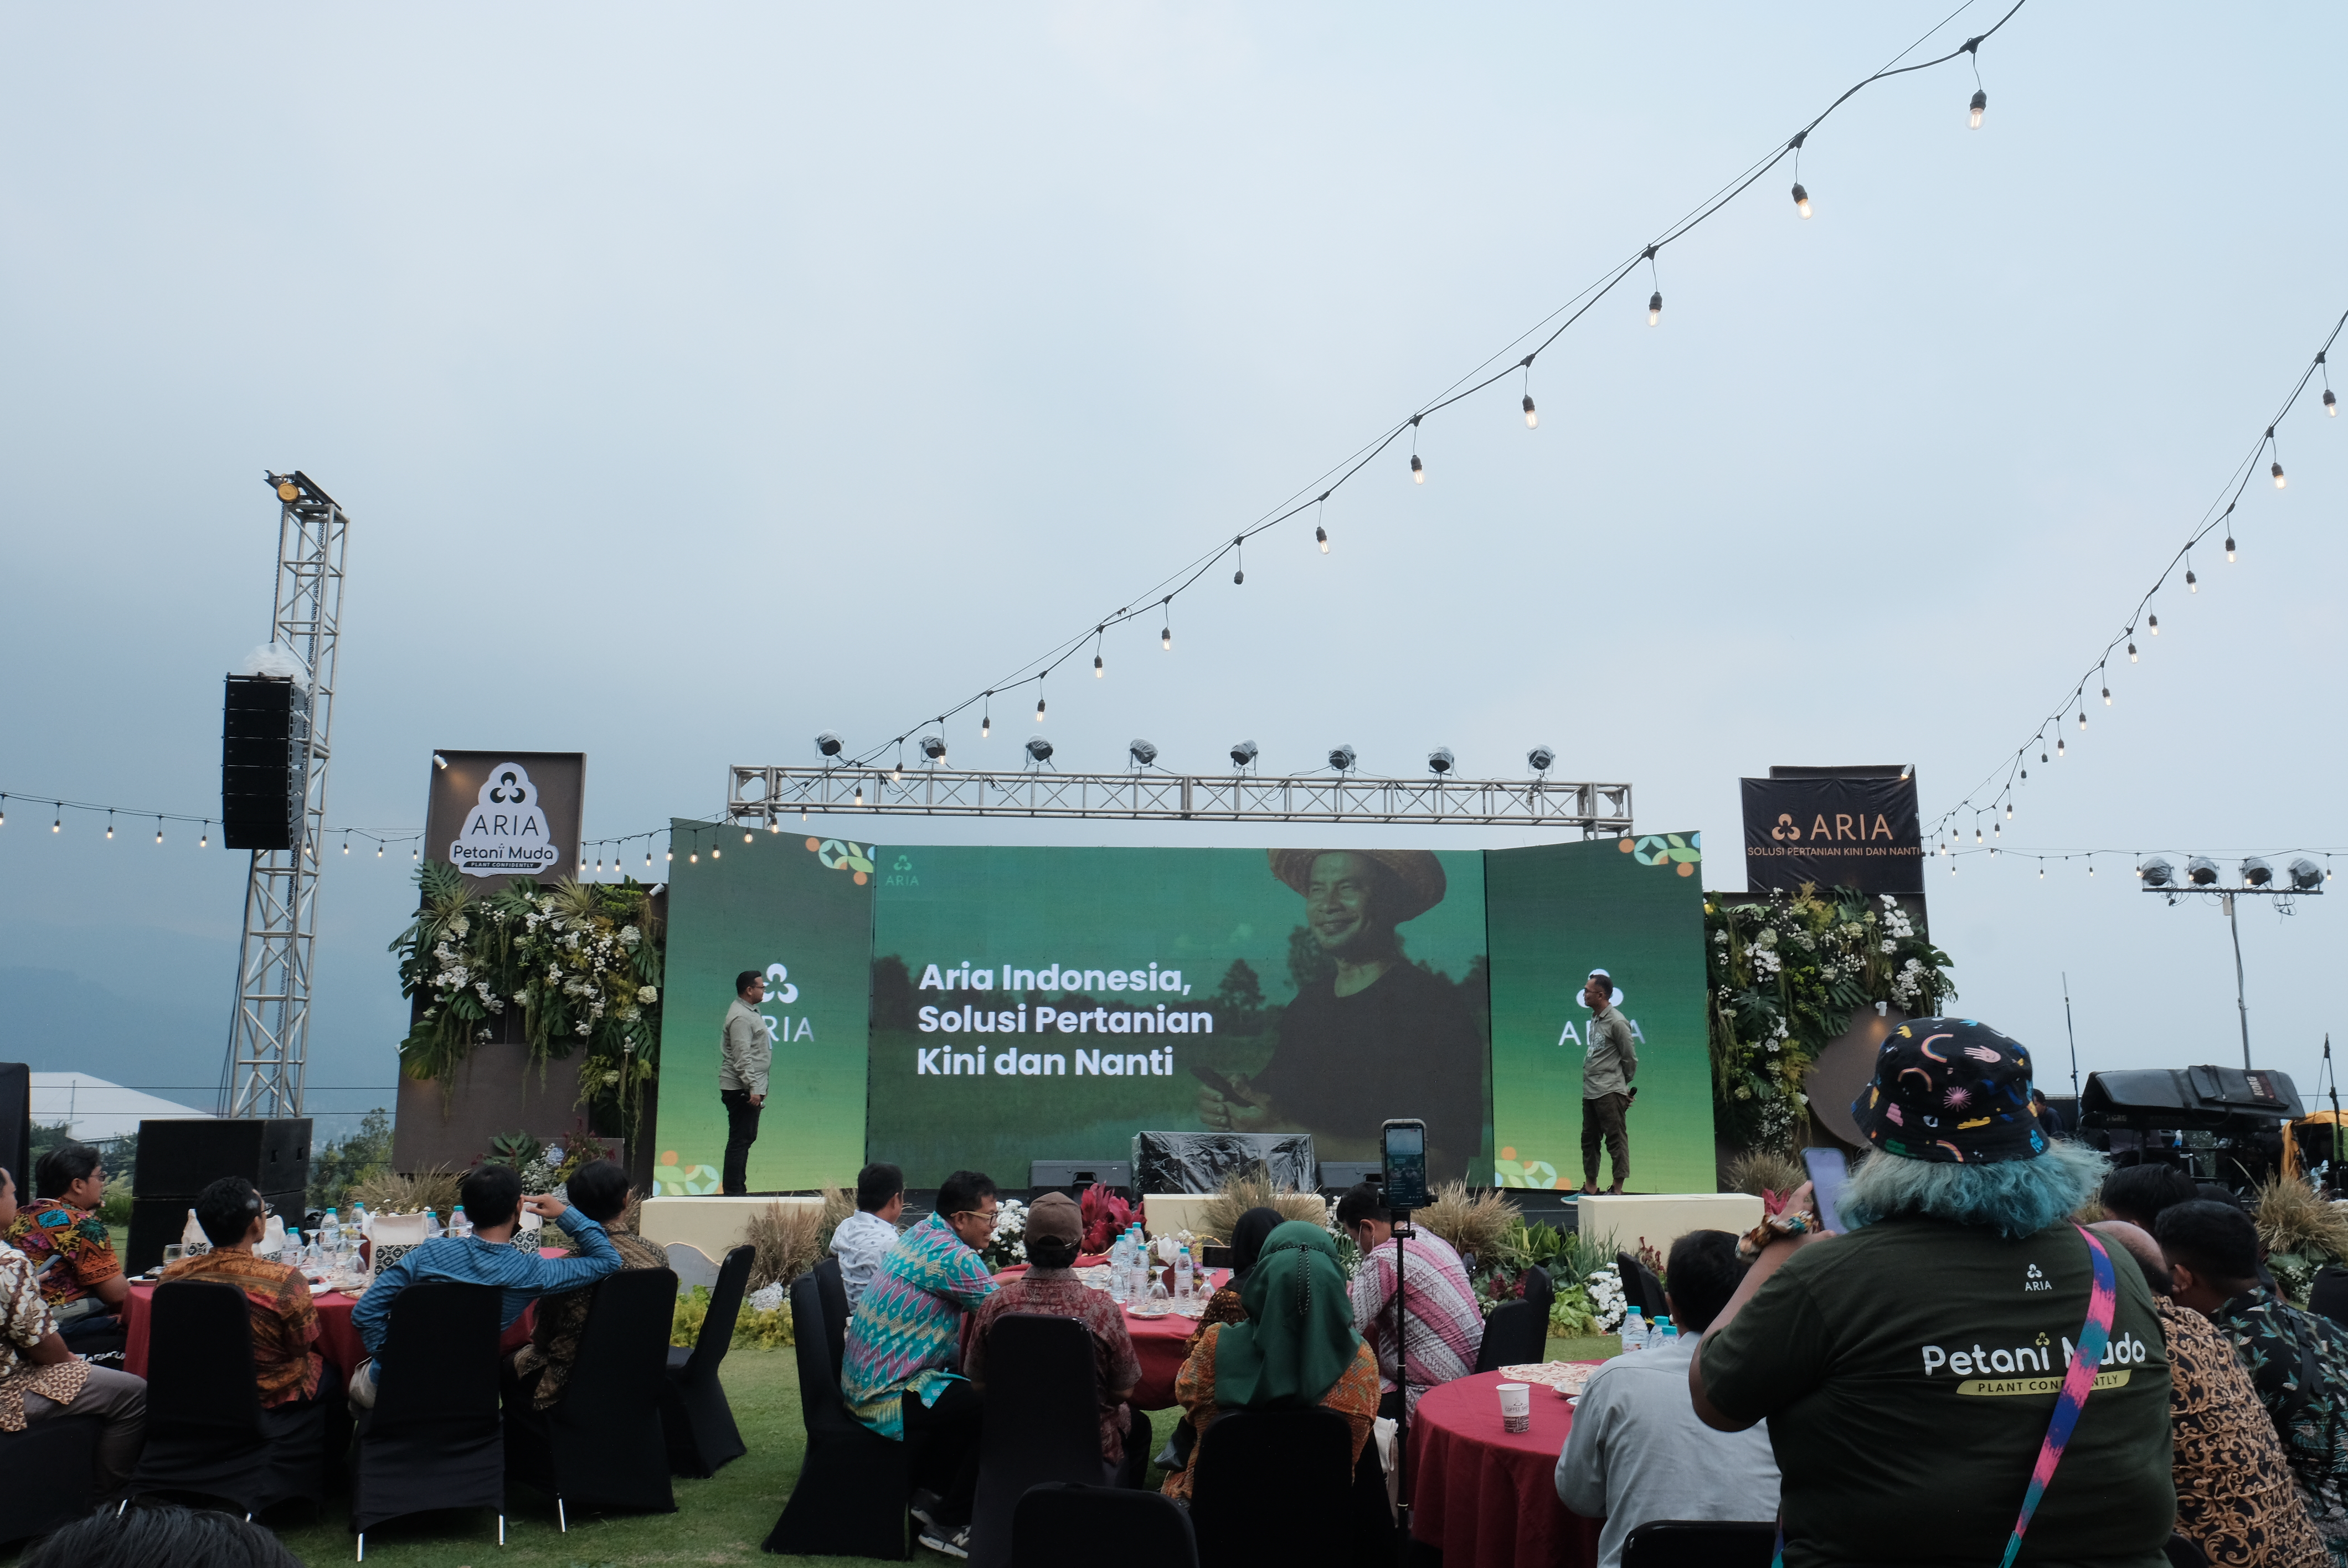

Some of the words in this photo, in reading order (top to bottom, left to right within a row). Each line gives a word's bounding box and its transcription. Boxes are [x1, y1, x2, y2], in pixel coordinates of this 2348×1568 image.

[471, 814, 539, 836] ARIA
[1810, 813, 1893, 840] ARIA
[454, 845, 503, 859] Petani
[509, 846, 553, 859] Muda
[1747, 847, 1784, 856] SOLUSI
[1787, 847, 1841, 856] PERTANIAN
[1844, 847, 1863, 856] KINI
[1866, 847, 1887, 856] DAN
[1889, 847, 1920, 856] NANTI
[887, 876, 919, 886] ARIA
[919, 961, 993, 990] Aria
[1003, 962, 1191, 996] Indonesia,
[761, 1015, 815, 1042] RIA
[918, 1003, 1026, 1033] Solusi
[1036, 1004, 1213, 1033] Pertanian
[1558, 1019, 1646, 1045] AA
[918, 1045, 986, 1075] Kini
[994, 1048, 1065, 1076] dan
[1075, 1045, 1173, 1076] Nanti
[2247, 1076, 2265, 1096] KORG
[2025, 1280, 2052, 1291] ARIA
[1922, 1344, 2050, 1376] Petani
[1978, 1382, 2023, 1392] PLANT
[2029, 1375, 2118, 1390] CONNTLY
